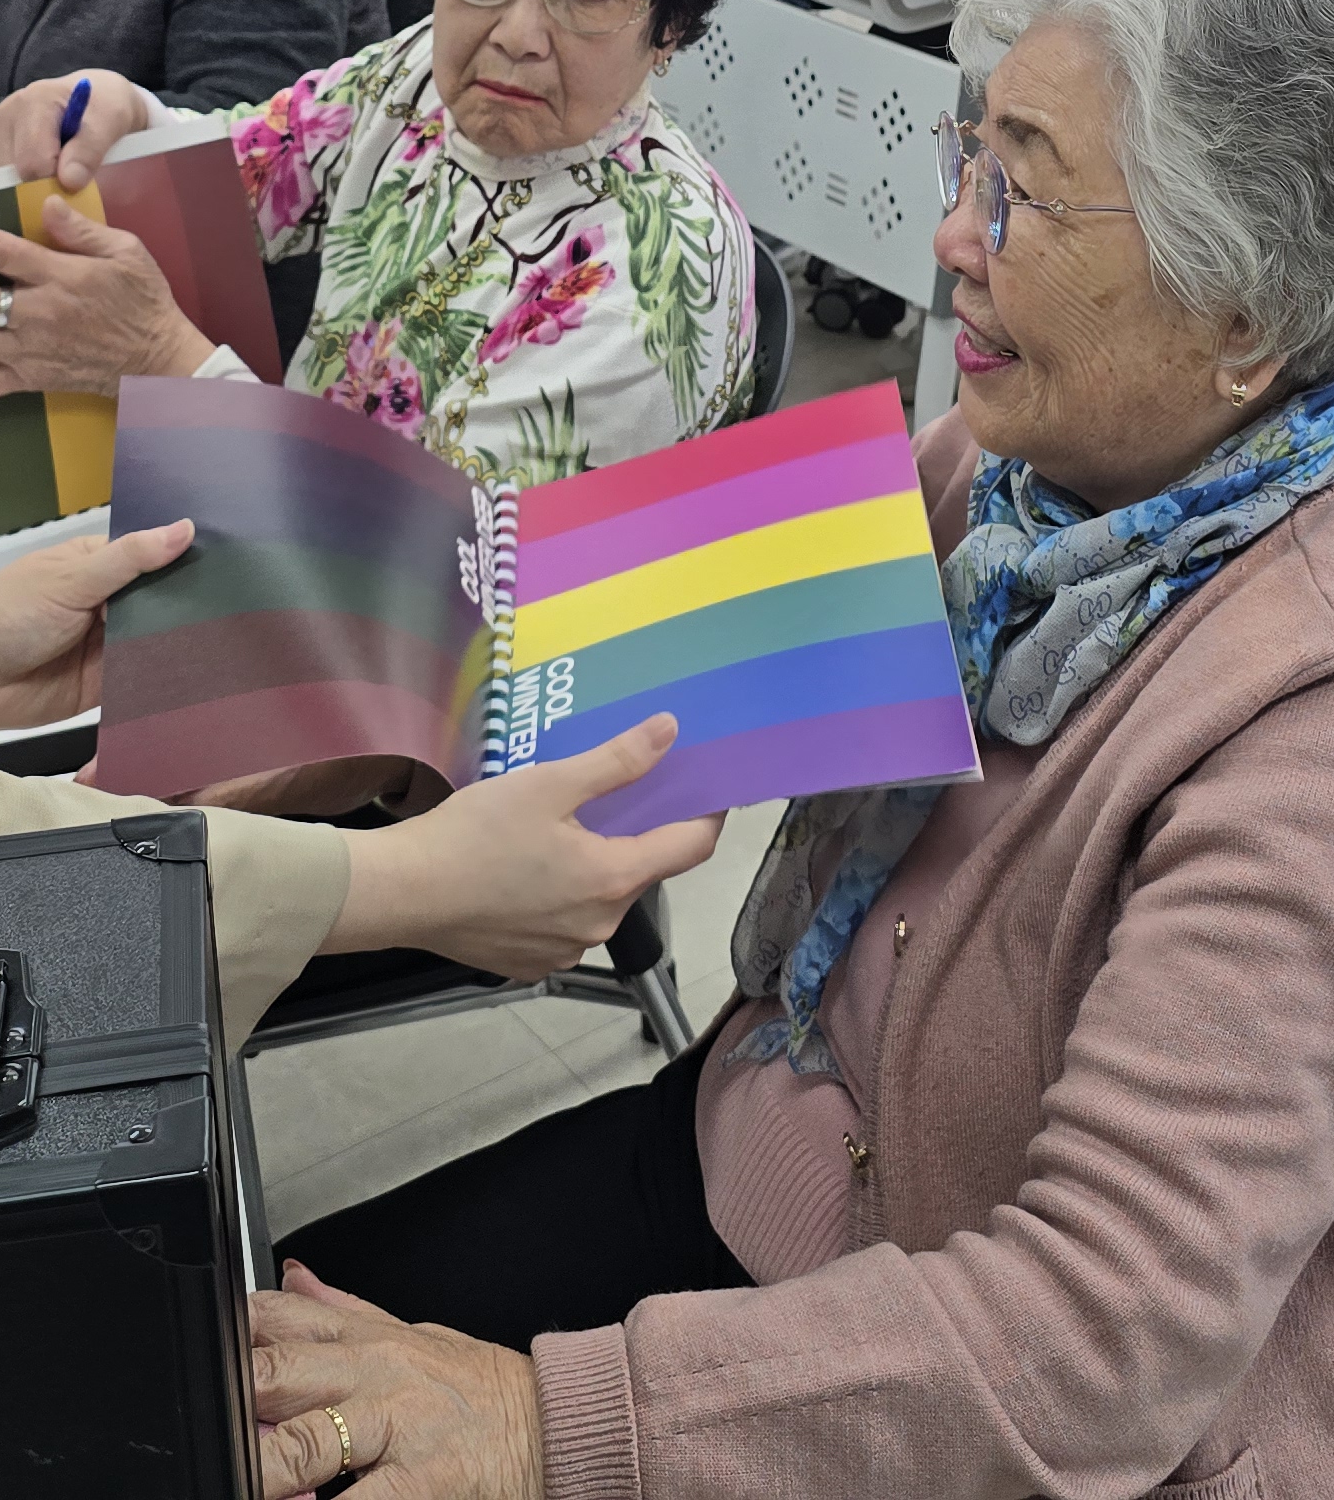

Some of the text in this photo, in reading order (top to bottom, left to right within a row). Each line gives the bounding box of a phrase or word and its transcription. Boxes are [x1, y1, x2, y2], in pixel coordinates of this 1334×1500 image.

[456, 536, 479, 605] COOL
[507, 665, 542, 766] WINTER
[544, 657, 575, 731] COOL
